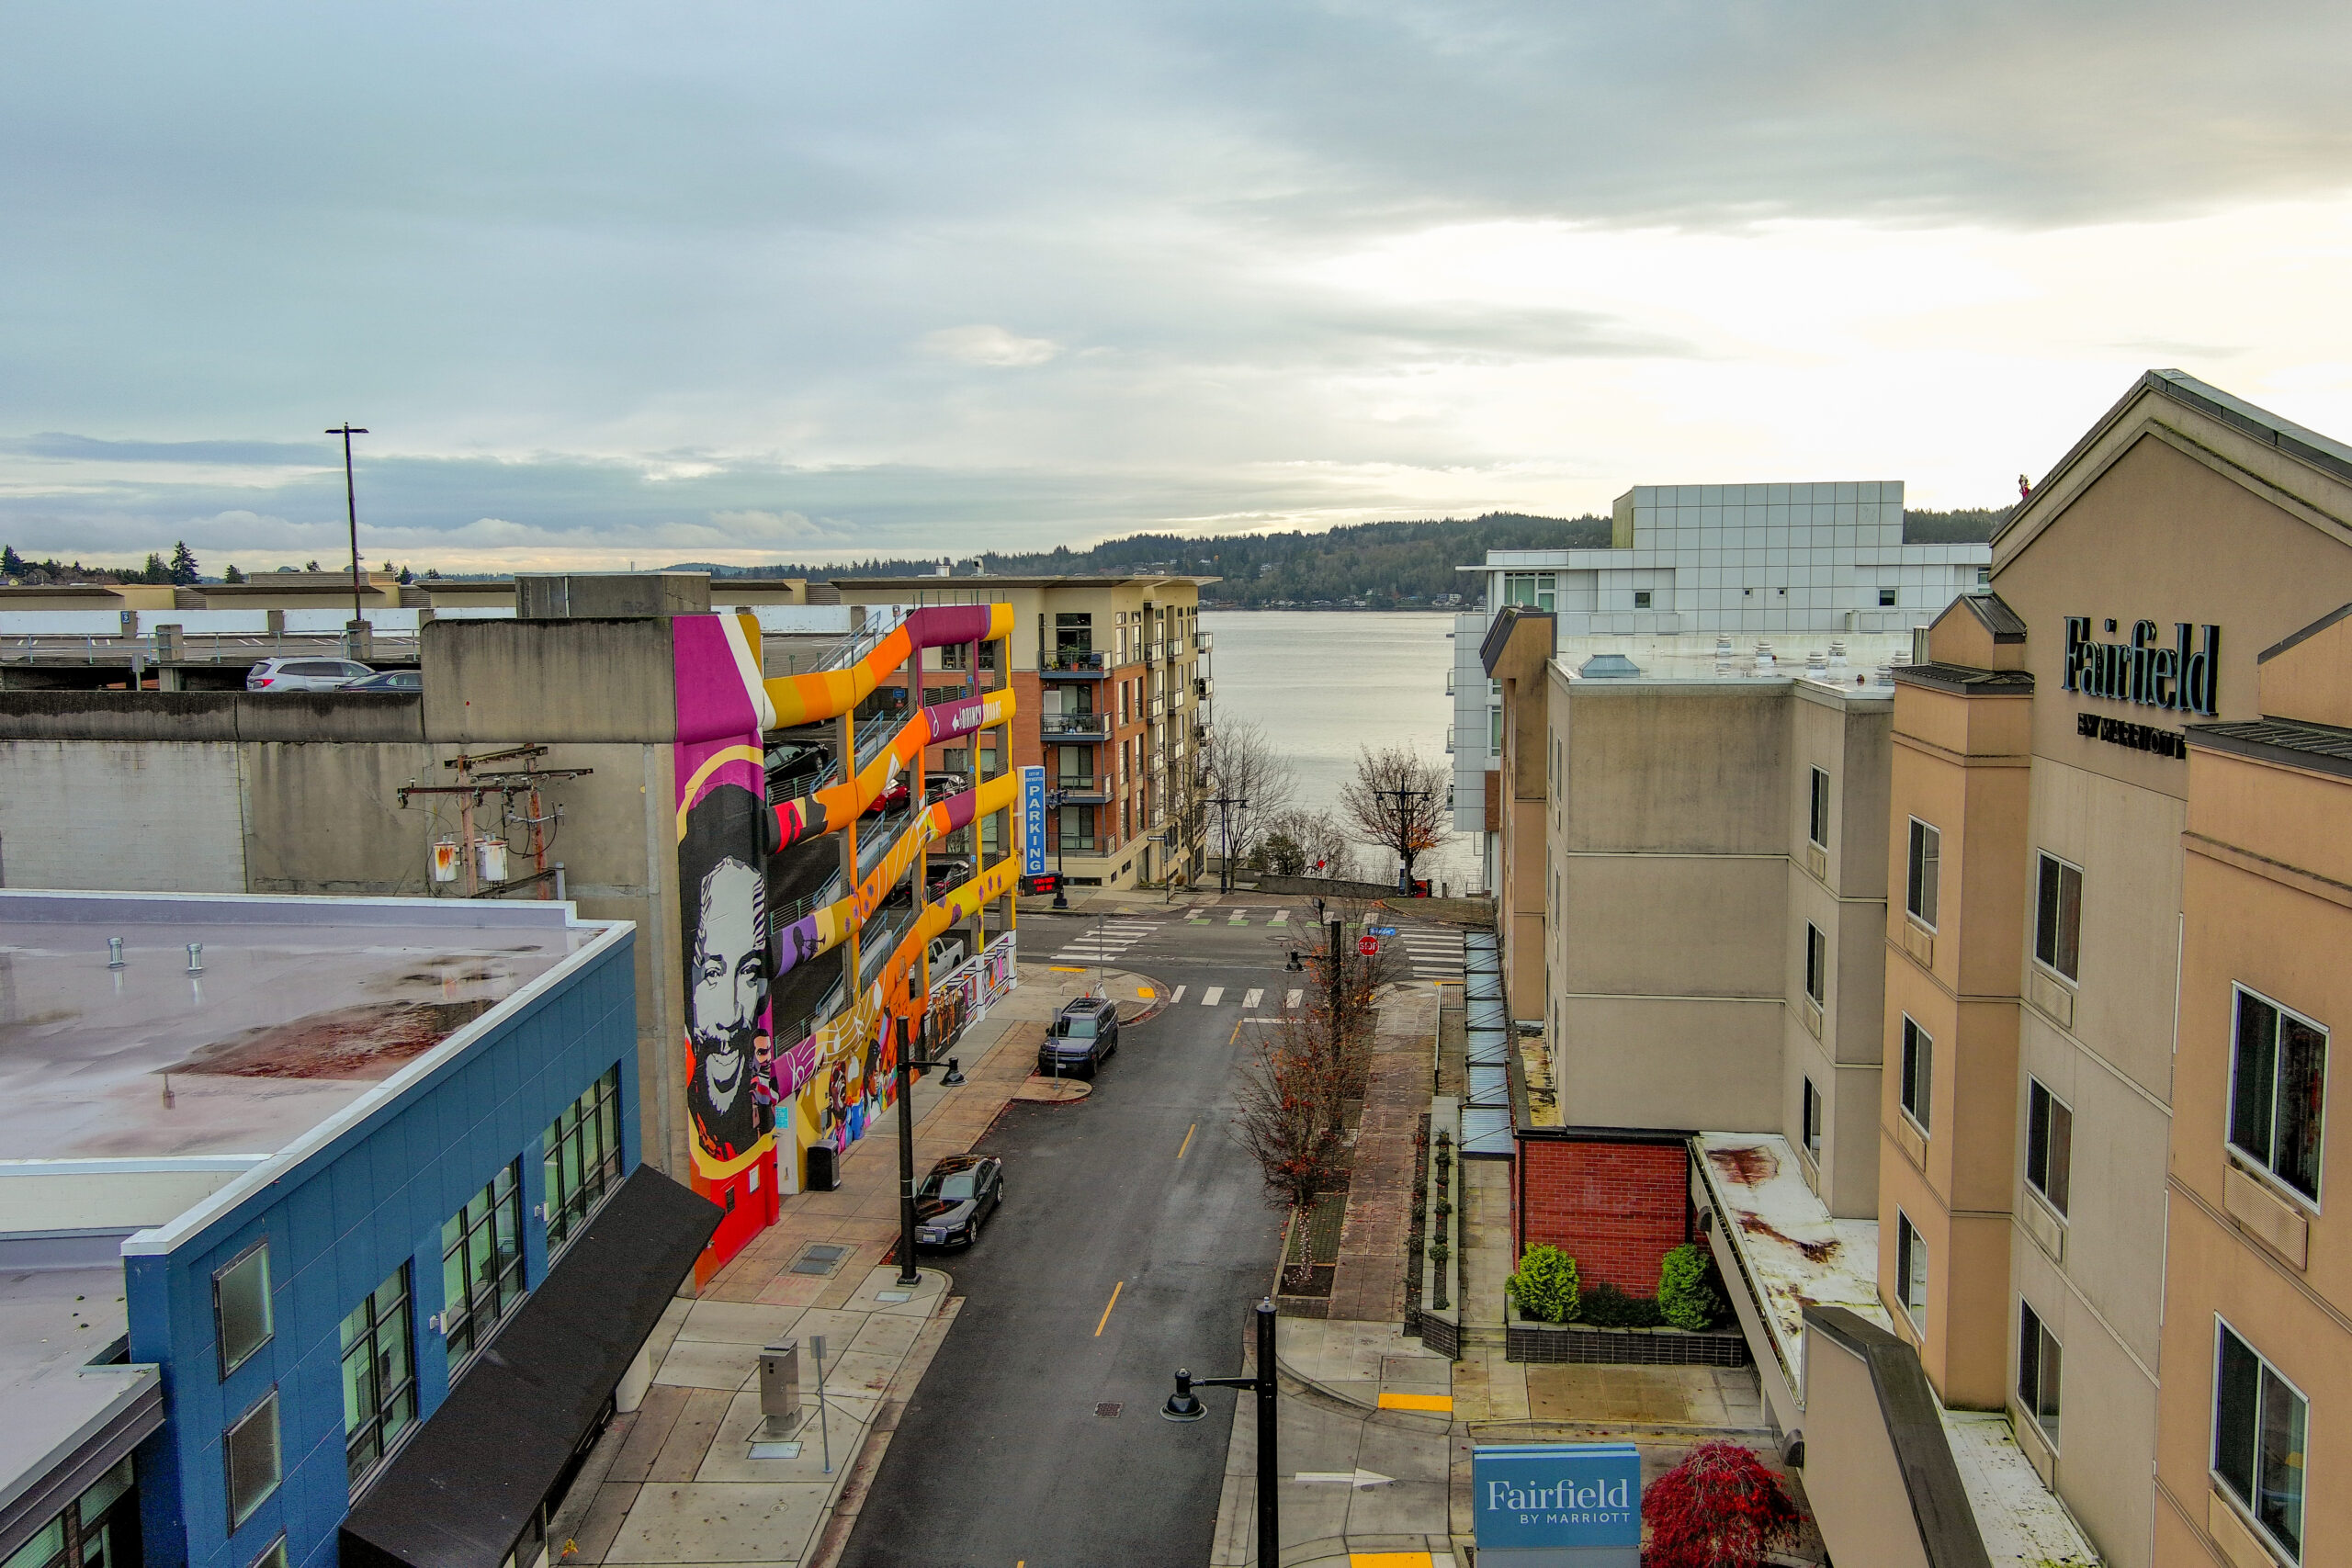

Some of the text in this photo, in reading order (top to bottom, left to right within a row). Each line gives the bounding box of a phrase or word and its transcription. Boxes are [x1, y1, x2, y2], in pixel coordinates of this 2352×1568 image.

[2061, 616, 2220, 716] Fairfield
[2077, 712, 2101, 738] BY
[1029, 785, 1041, 870] PARKING
[1360, 942, 1377, 950] STOP
[1486, 1478, 1630, 1510] Fairfield
[1521, 1512, 1630, 1524] BY MARRIOTT
